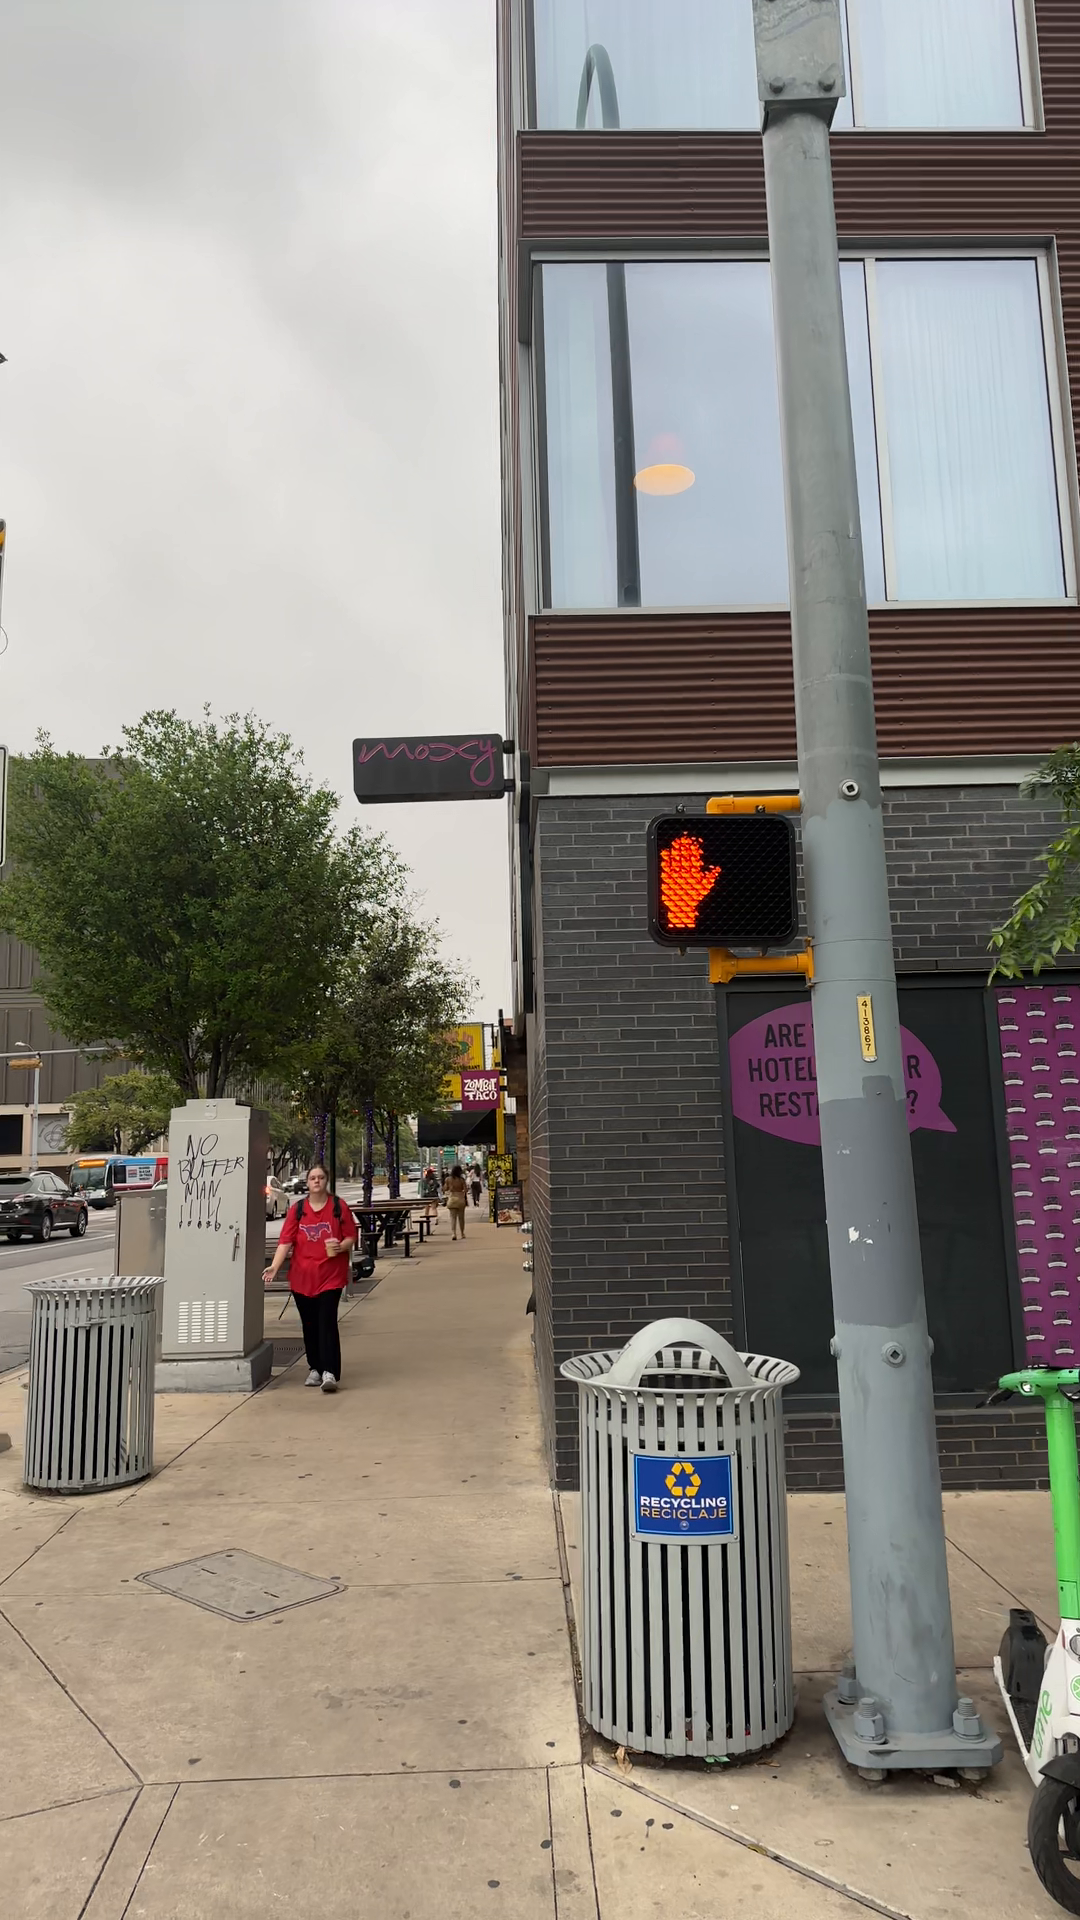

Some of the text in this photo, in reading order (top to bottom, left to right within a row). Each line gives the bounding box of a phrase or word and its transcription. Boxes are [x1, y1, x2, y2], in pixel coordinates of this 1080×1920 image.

[764, 1023, 807, 1049] ARE
[861, 1000, 872, 1052] 413867
[464, 1090, 498, 1101] TACO
[759, 1091, 820, 1118] REST
[186, 1133, 219, 1160] NO
[178, 1156, 245, 1185] BUFFER
[184, 1179, 222, 1203] MAN
[640, 1496, 728, 1509] RECYCLING
[640, 1507, 728, 1520] RECICLAJE
